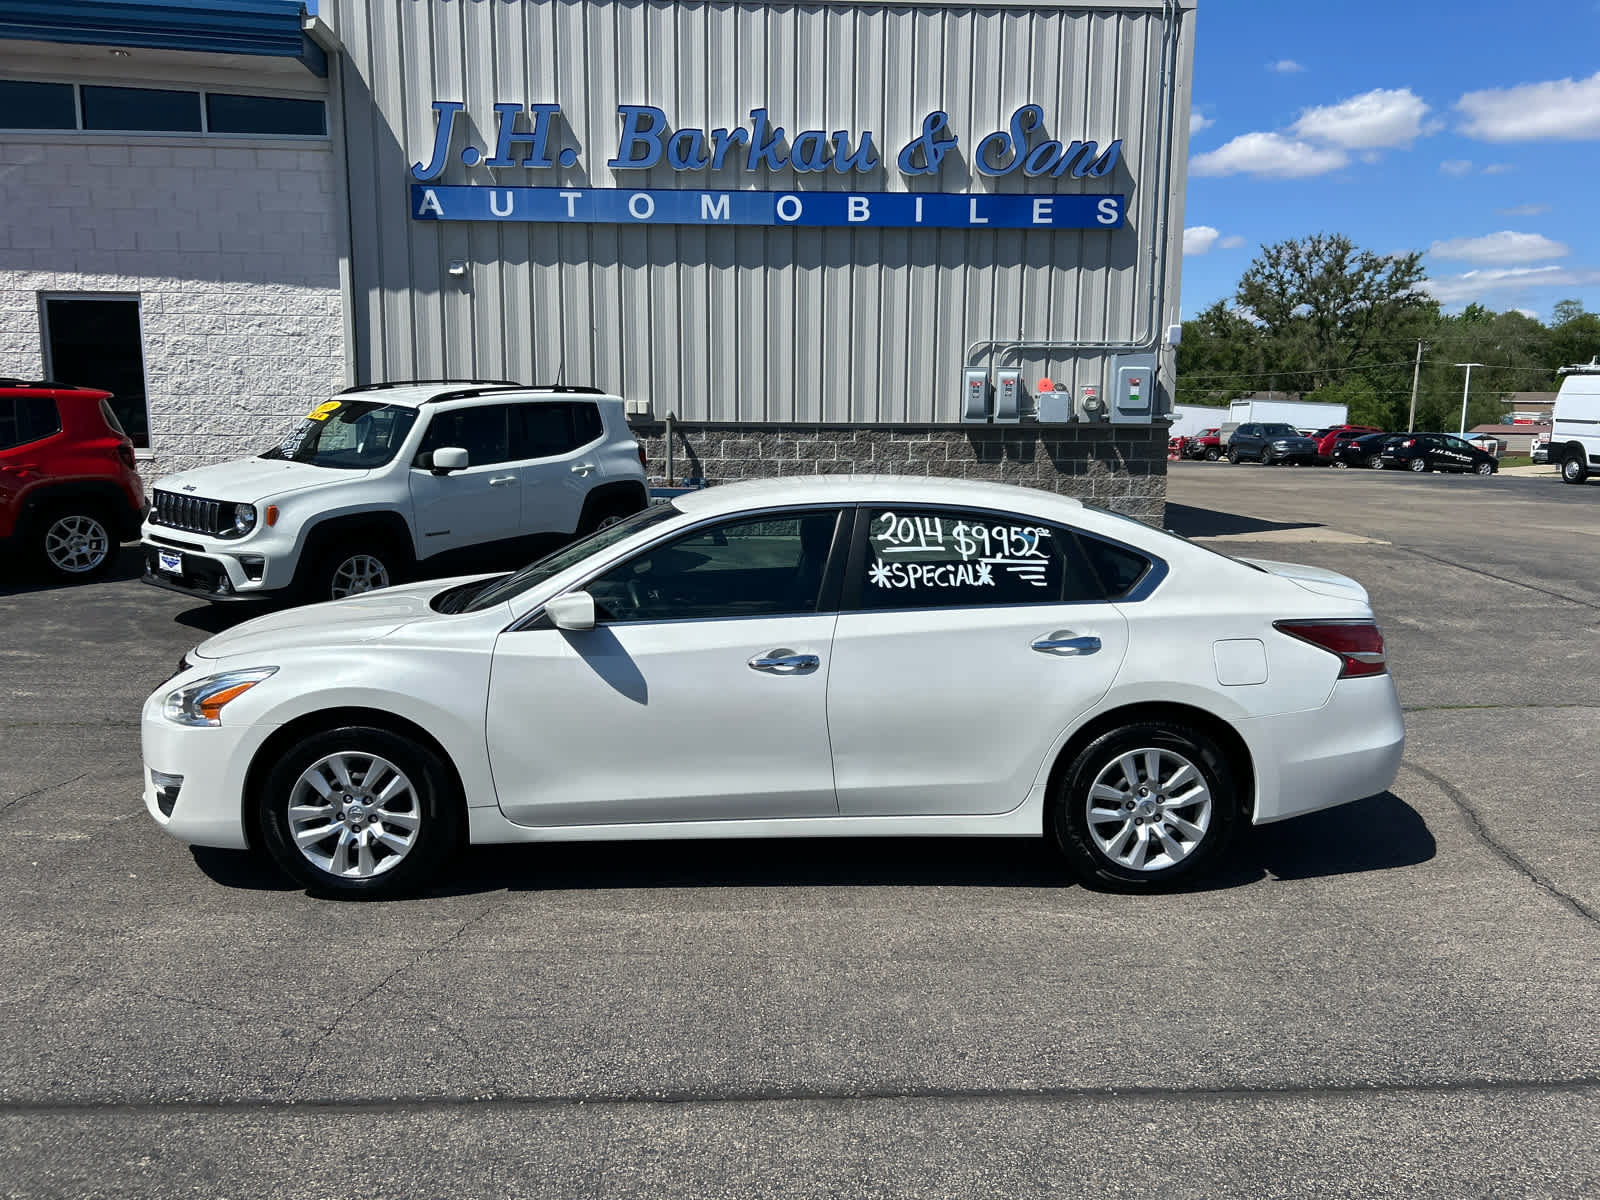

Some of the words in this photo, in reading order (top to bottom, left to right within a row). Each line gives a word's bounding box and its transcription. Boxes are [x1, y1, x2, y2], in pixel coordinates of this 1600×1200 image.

[411, 101, 577, 181] J.H.
[607, 104, 878, 173] Barkau
[897, 110, 958, 176] &
[975, 103, 1123, 178] Sons
[418, 189, 1119, 225] AUTOMOBILES
[877, 512, 943, 548] 2014
